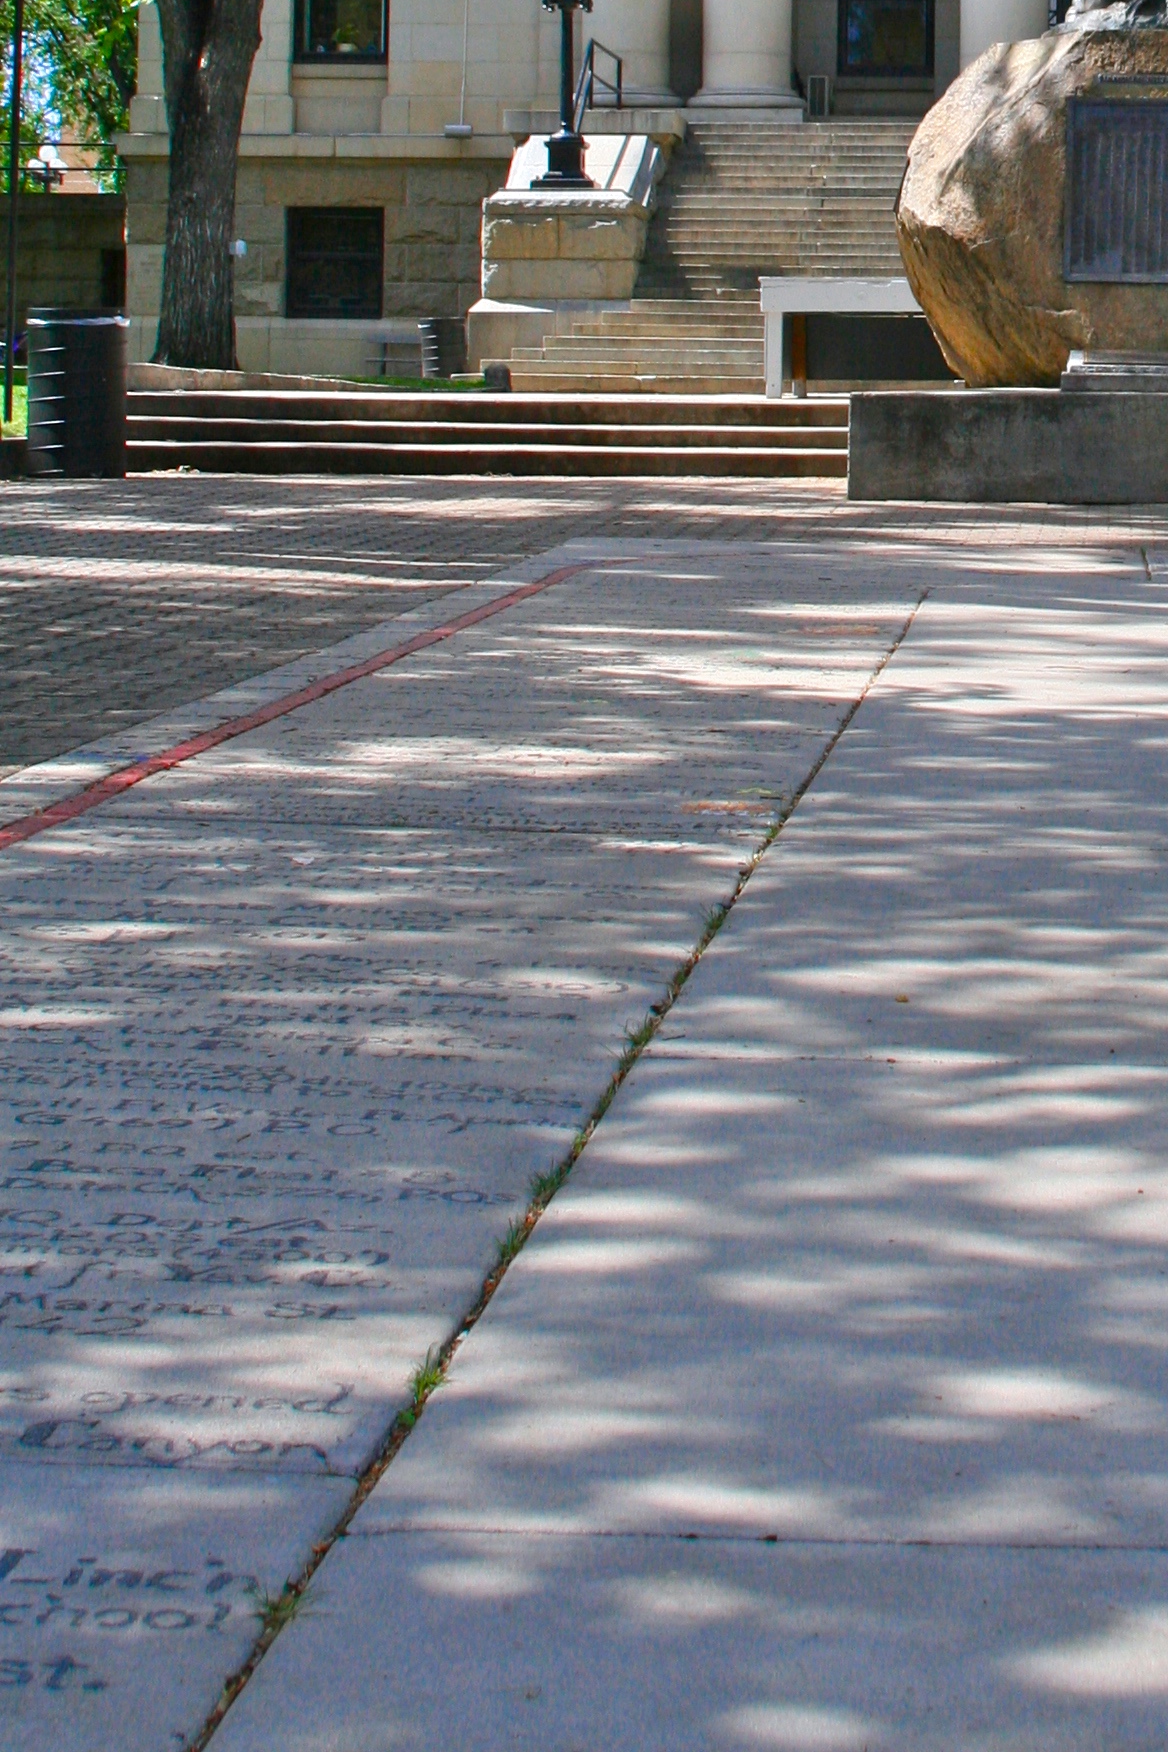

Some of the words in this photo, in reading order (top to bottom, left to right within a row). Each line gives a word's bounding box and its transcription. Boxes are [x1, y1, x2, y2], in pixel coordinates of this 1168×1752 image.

[0, 1290, 235, 1318] Marina
[78, 1381, 357, 1417] opened
[18, 1418, 336, 1470] Canyon
